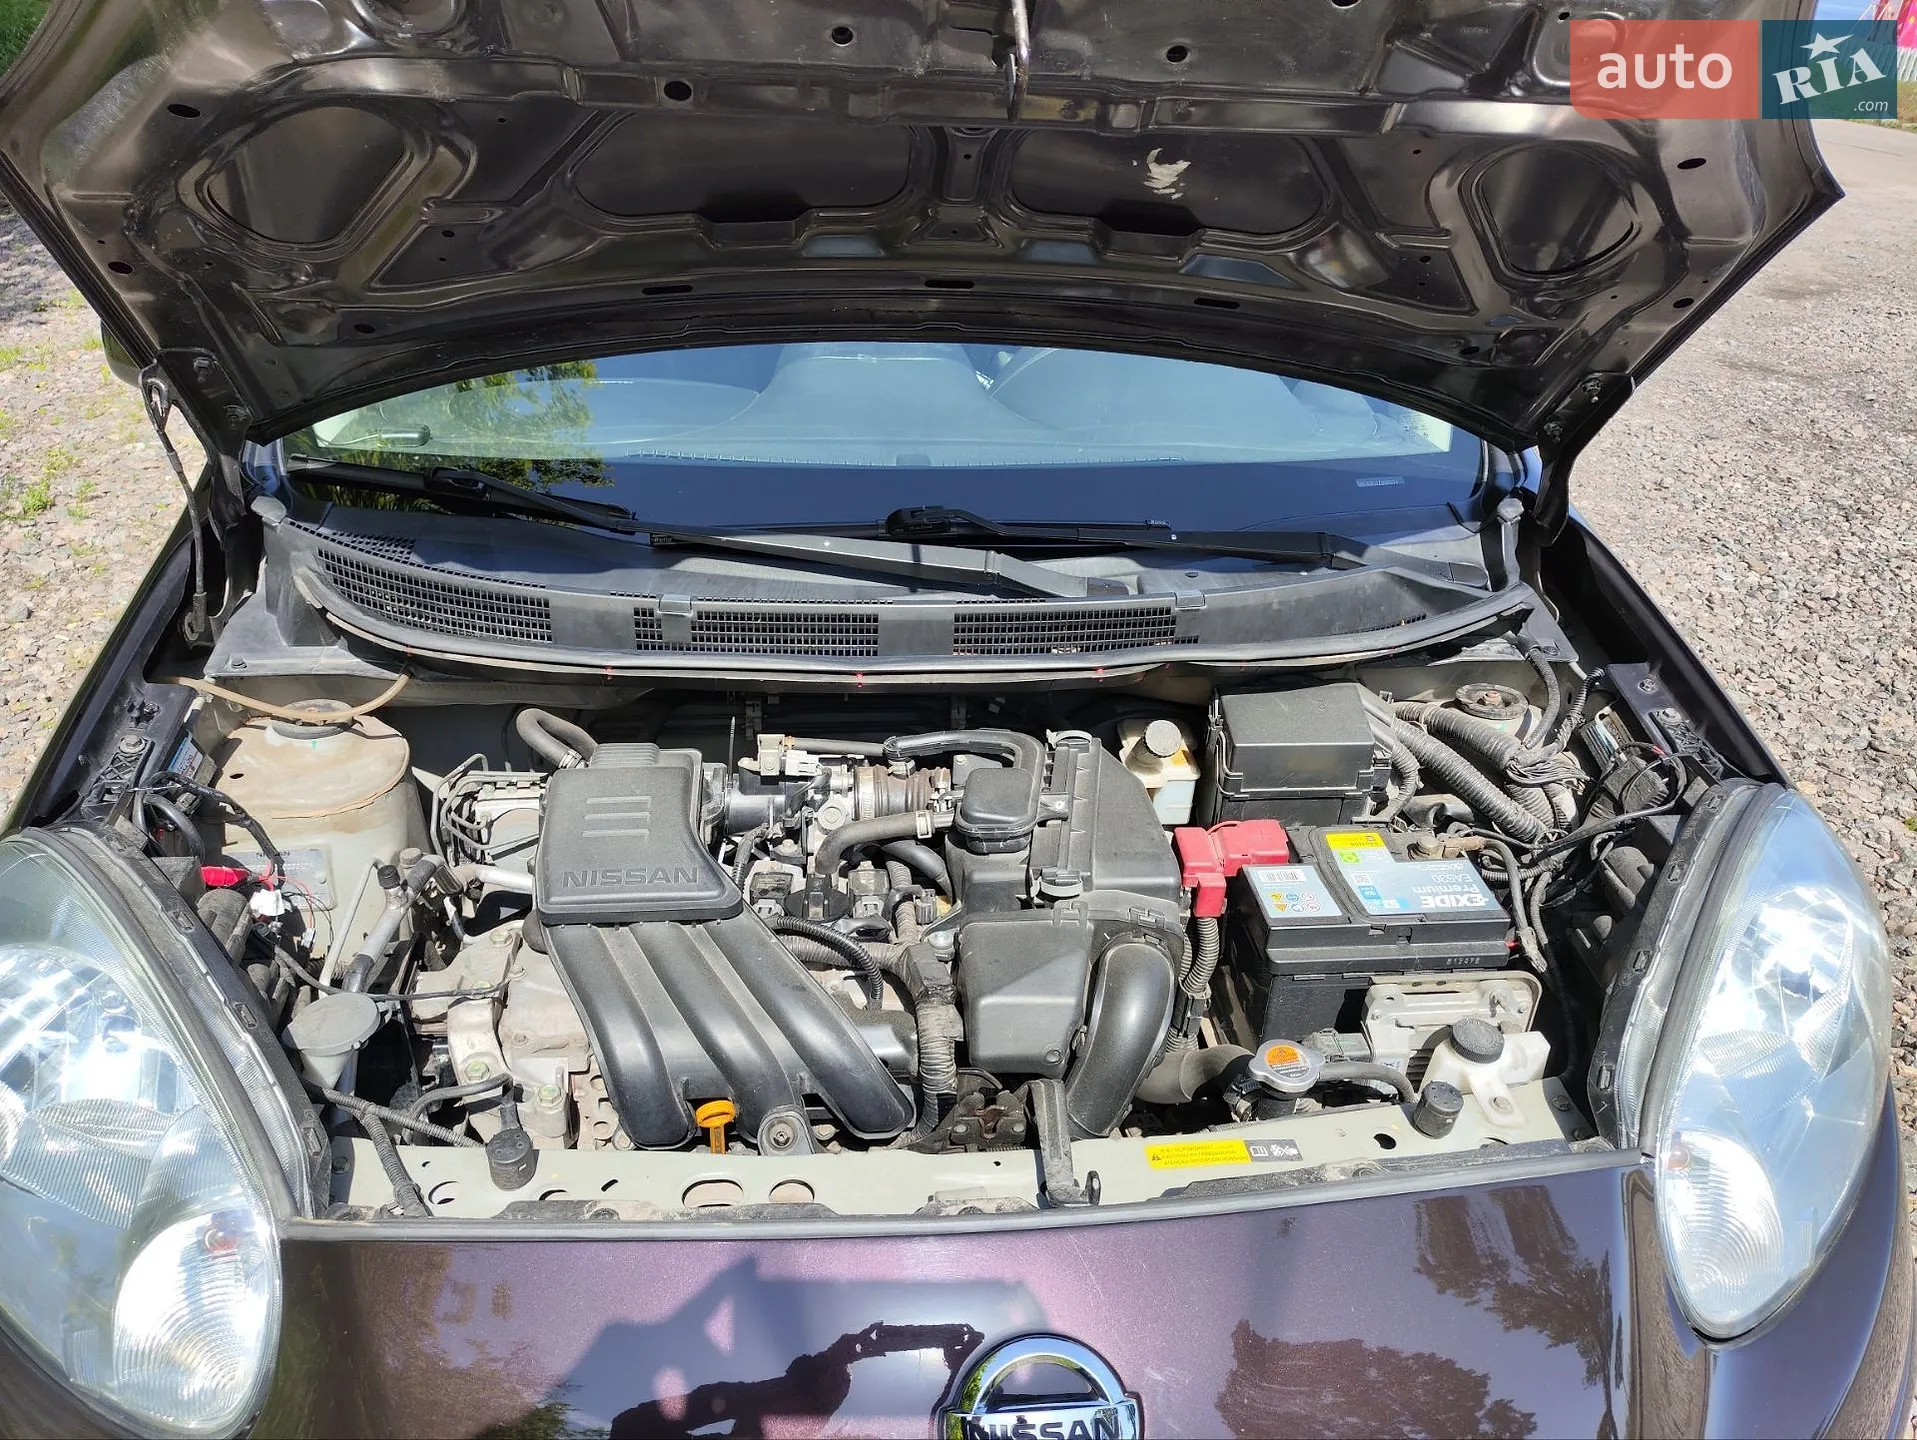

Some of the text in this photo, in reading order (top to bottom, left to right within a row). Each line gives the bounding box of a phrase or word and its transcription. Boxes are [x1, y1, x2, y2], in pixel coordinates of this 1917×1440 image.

[562, 867, 699, 888] NISSAN
[1412, 883, 1481, 894] Premium
[1420, 893, 1488, 909] EXIDE
[966, 1410, 1121, 1440] NISSAN
